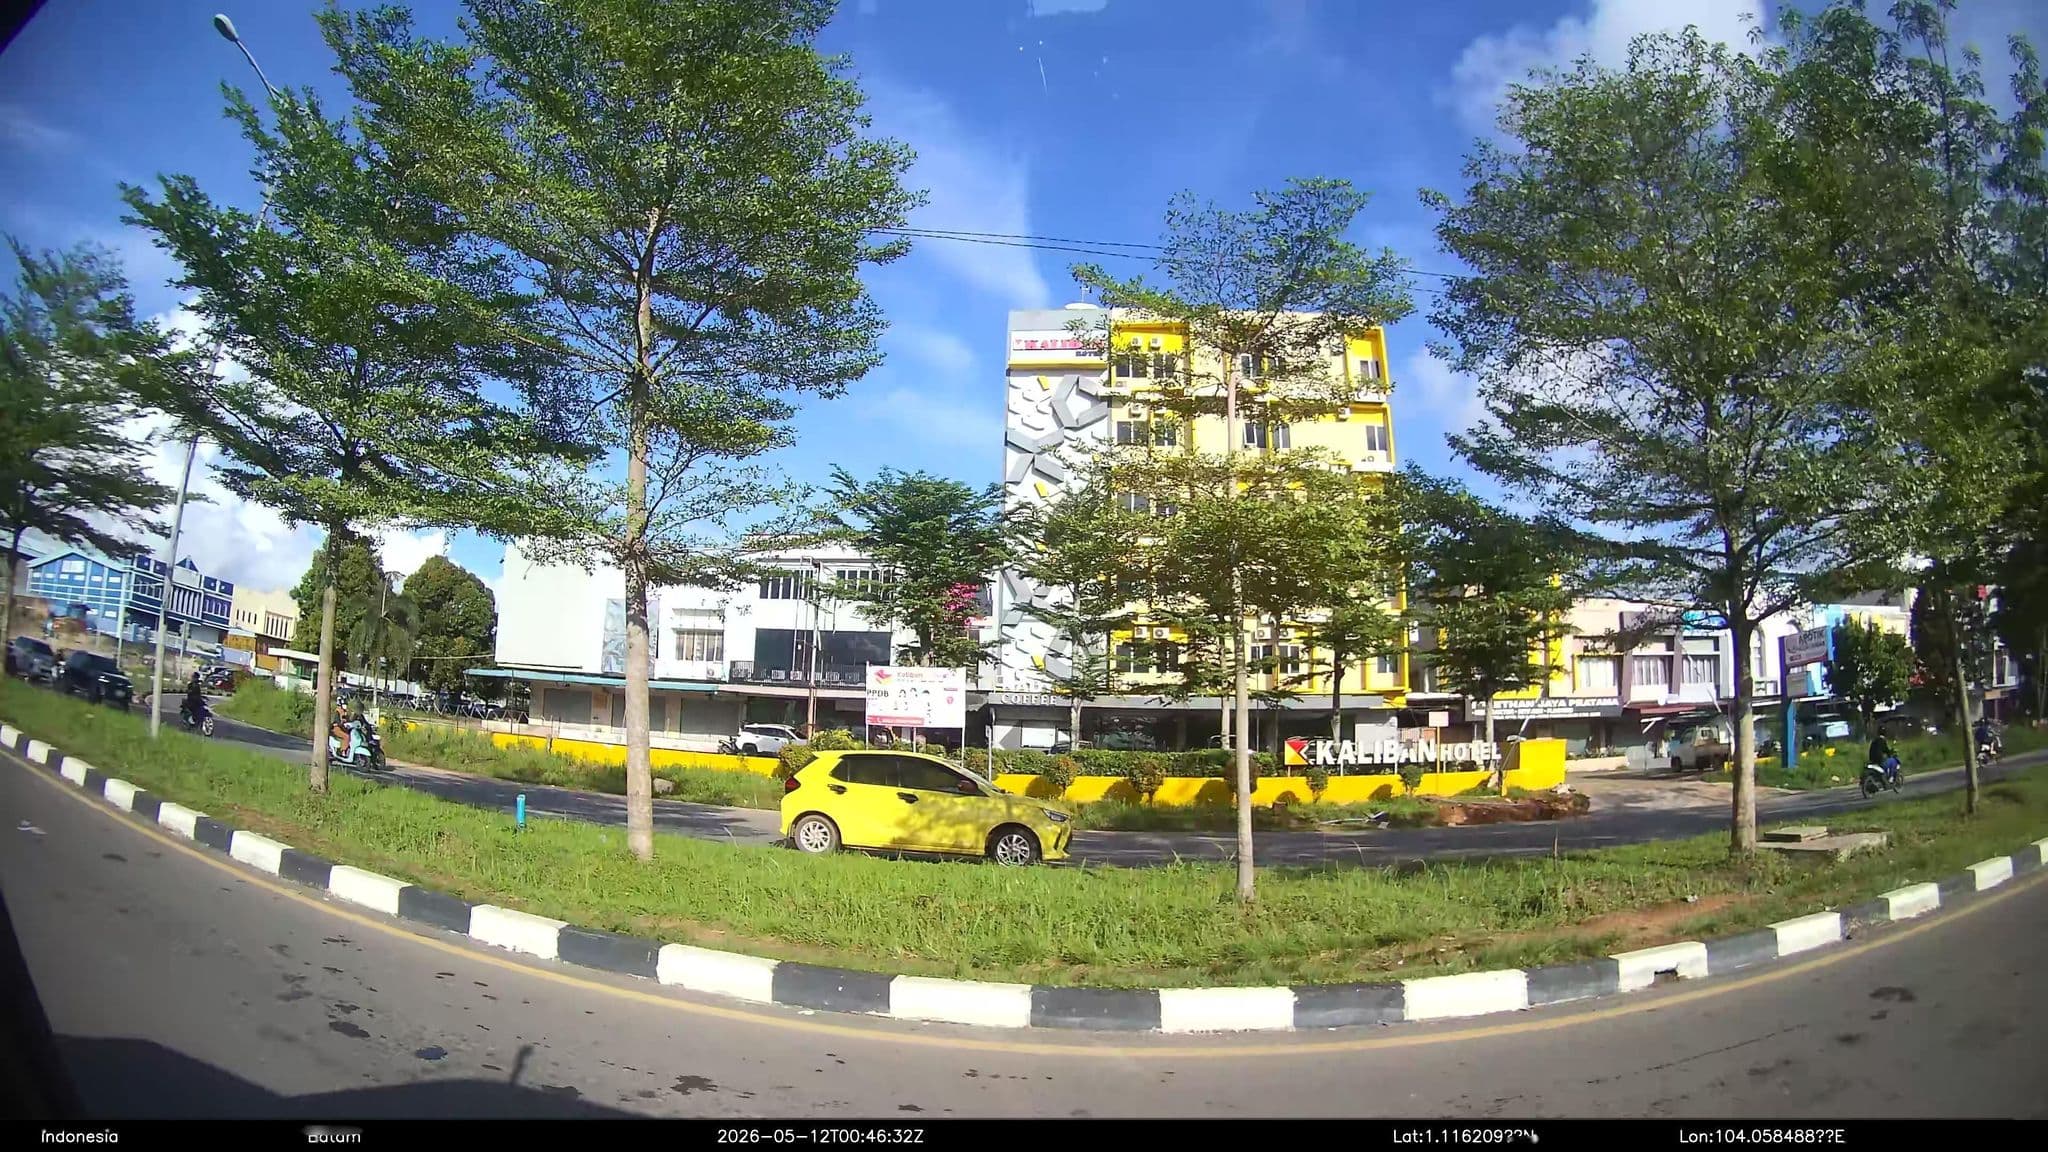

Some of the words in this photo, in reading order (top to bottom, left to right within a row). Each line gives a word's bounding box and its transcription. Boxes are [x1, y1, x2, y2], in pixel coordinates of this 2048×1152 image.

[866, 689, 889, 697] PPDB
[1001, 694, 1057, 705] COFFEE
[1316, 739, 1437, 765] KALIBAN
[1440, 744, 1502, 762] HOTEL
